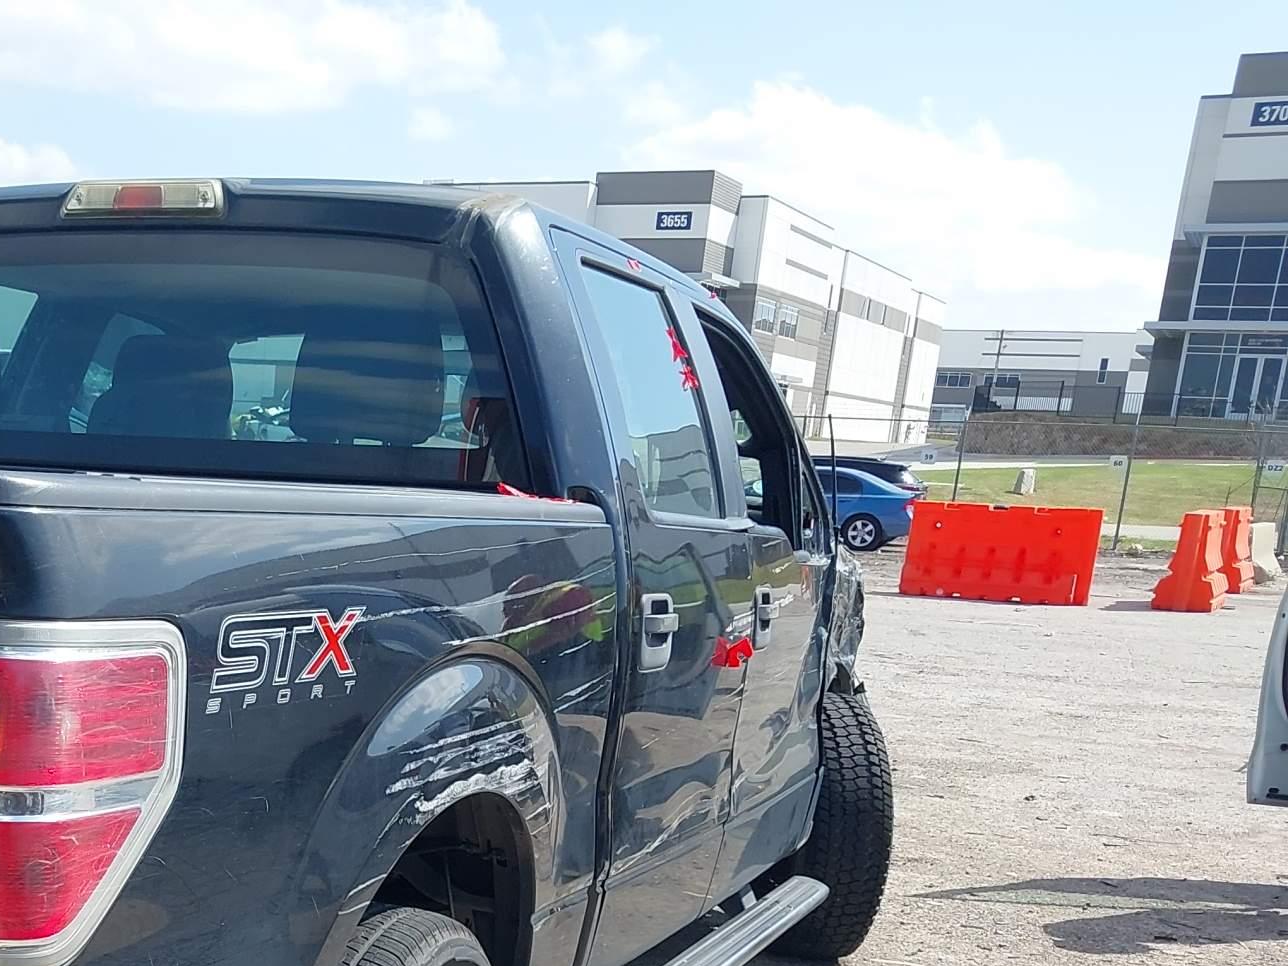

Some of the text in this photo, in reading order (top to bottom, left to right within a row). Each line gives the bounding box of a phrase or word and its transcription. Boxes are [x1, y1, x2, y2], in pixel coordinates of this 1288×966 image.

[1258, 105, 1288, 122] 370
[660, 214, 689, 228] 3655
[210, 606, 367, 694] STX
[205, 680, 356, 714] SPORT
